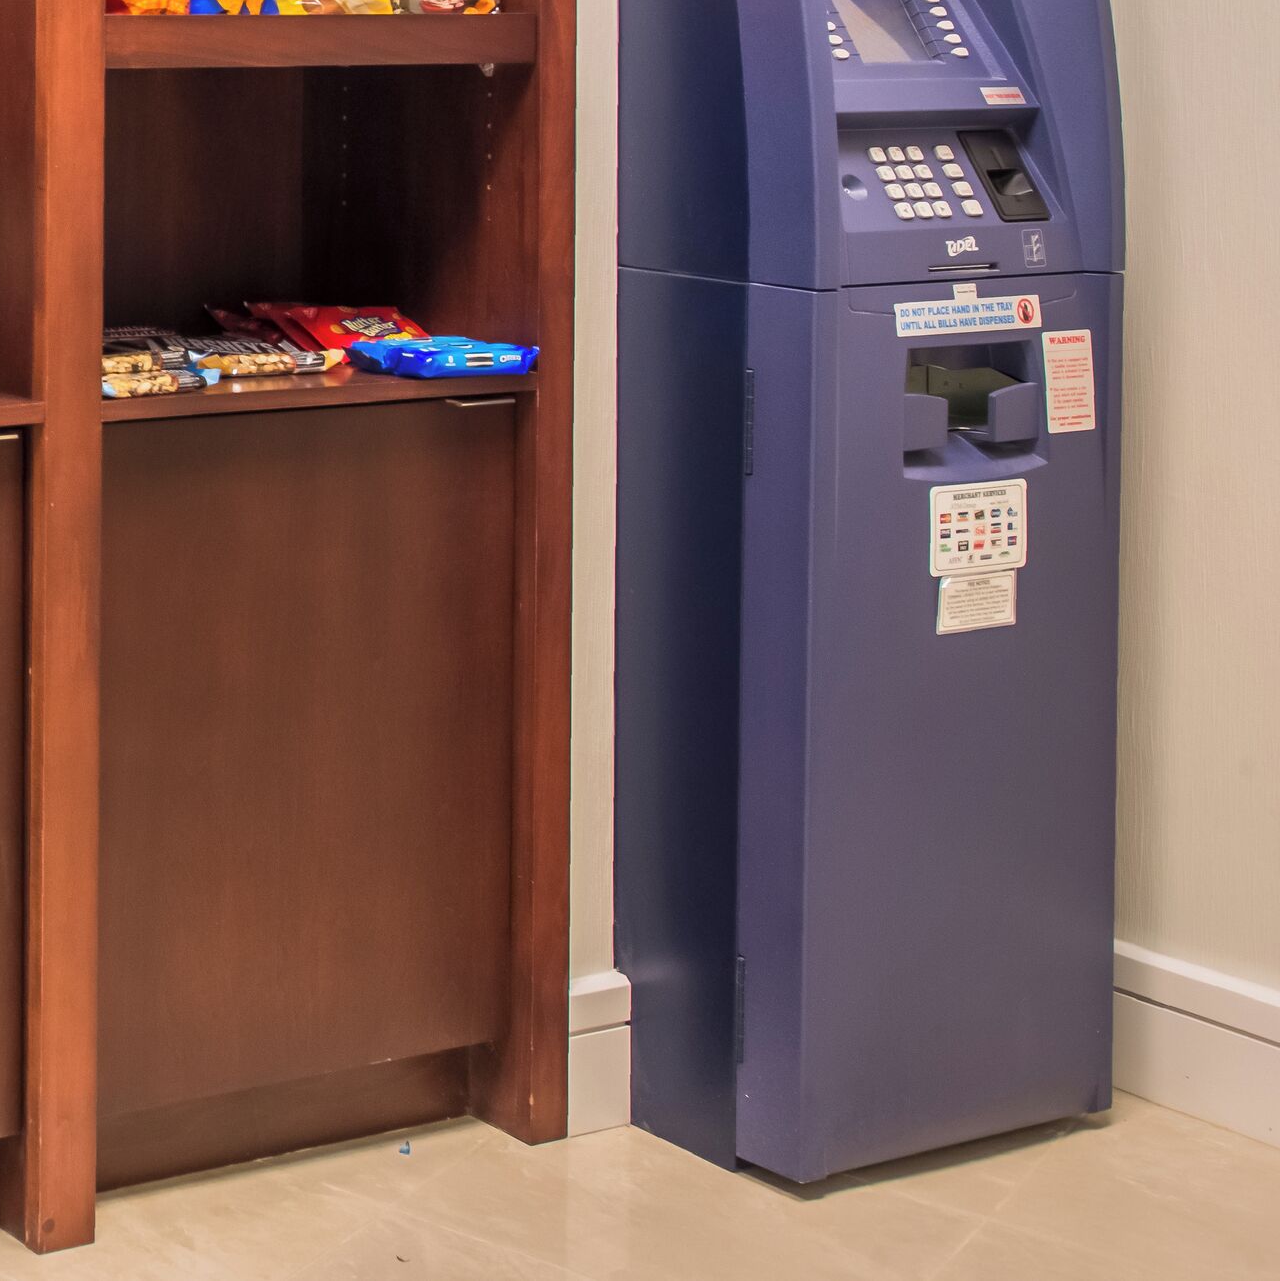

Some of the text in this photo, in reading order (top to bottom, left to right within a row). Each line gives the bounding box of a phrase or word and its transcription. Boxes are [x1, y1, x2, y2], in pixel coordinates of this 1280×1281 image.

[900, 302, 1014, 318] DO NOT PLACE HAND IN THE TRAY
[341, 317, 383, 333] Nutter
[359, 321, 398, 338] Butter
[901, 314, 1016, 331] UNTIL ALL BILLS HAVE DISPENSED
[1049, 335, 1086, 345] WARNING
[953, 492, 982, 501] MERCHANT
